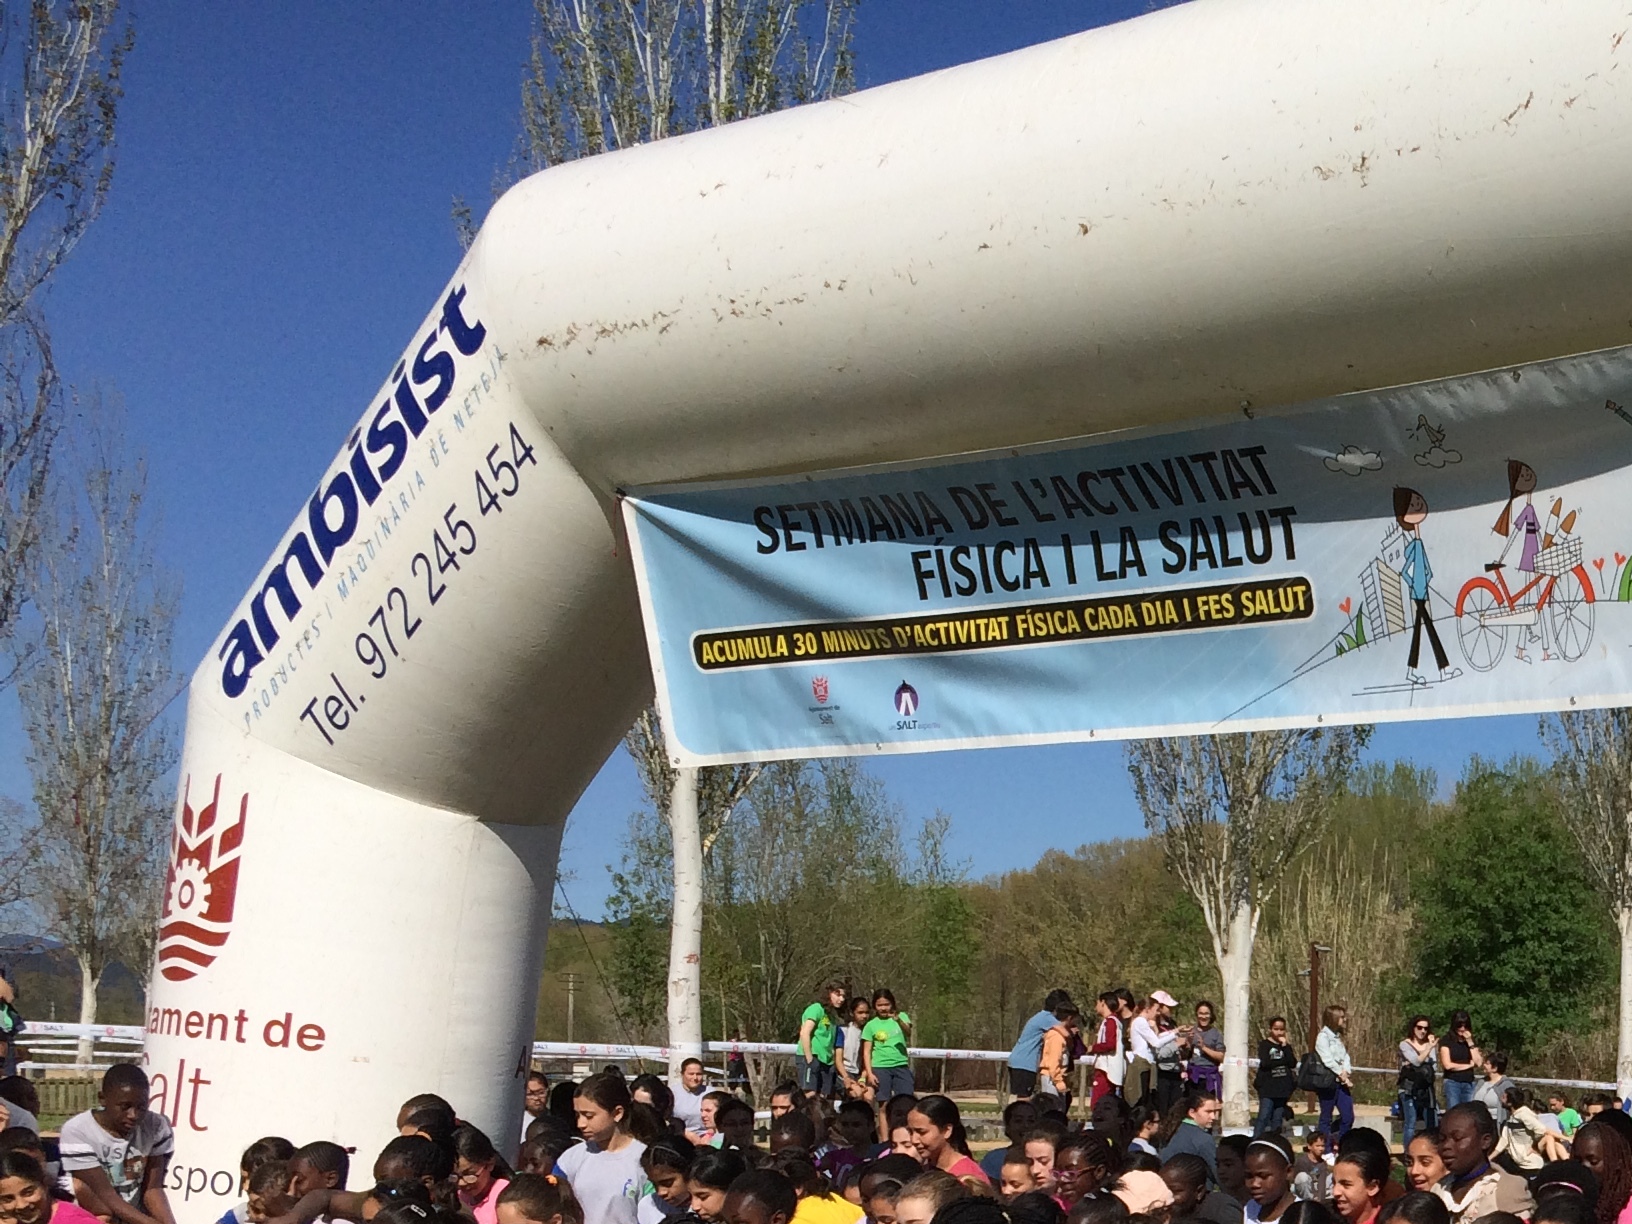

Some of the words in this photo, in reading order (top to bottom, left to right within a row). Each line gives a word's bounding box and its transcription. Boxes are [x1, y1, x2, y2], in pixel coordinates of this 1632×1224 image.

[220, 283, 486, 699] ambisist
[430, 434, 449, 468] DE
[753, 491, 954, 554] SETMANA
[947, 483, 1019, 530] DE
[1011, 445, 1278, 522] L'ACTIVITAT
[300, 672, 366, 746] Tel.
[356, 587, 422, 679] 972
[412, 503, 476, 606] 245
[475, 422, 537, 516] 454
[911, 537, 1051, 600] FÍSICA
[1061, 534, 1077, 585] I
[1090, 526, 1147, 581] LA
[1158, 506, 1297, 574] SALUT
[702, 634, 788, 664] ACUMULA
[794, 632, 817, 656] 30
[822, 627, 891, 653] MINUTS
[892, 616, 1010, 648] D'ACTIVITAT
[1017, 608, 1081, 638] FÍSICA
[1084, 603, 1139, 631] CADA
[1141, 599, 1179, 625] DIA
[1183, 598, 1192, 622] I
[1196, 593, 1235, 621] FES
[1240, 585, 1307, 617] SALUT
[896, 720, 918, 730] SALT
[263, 1012, 326, 1051] de
